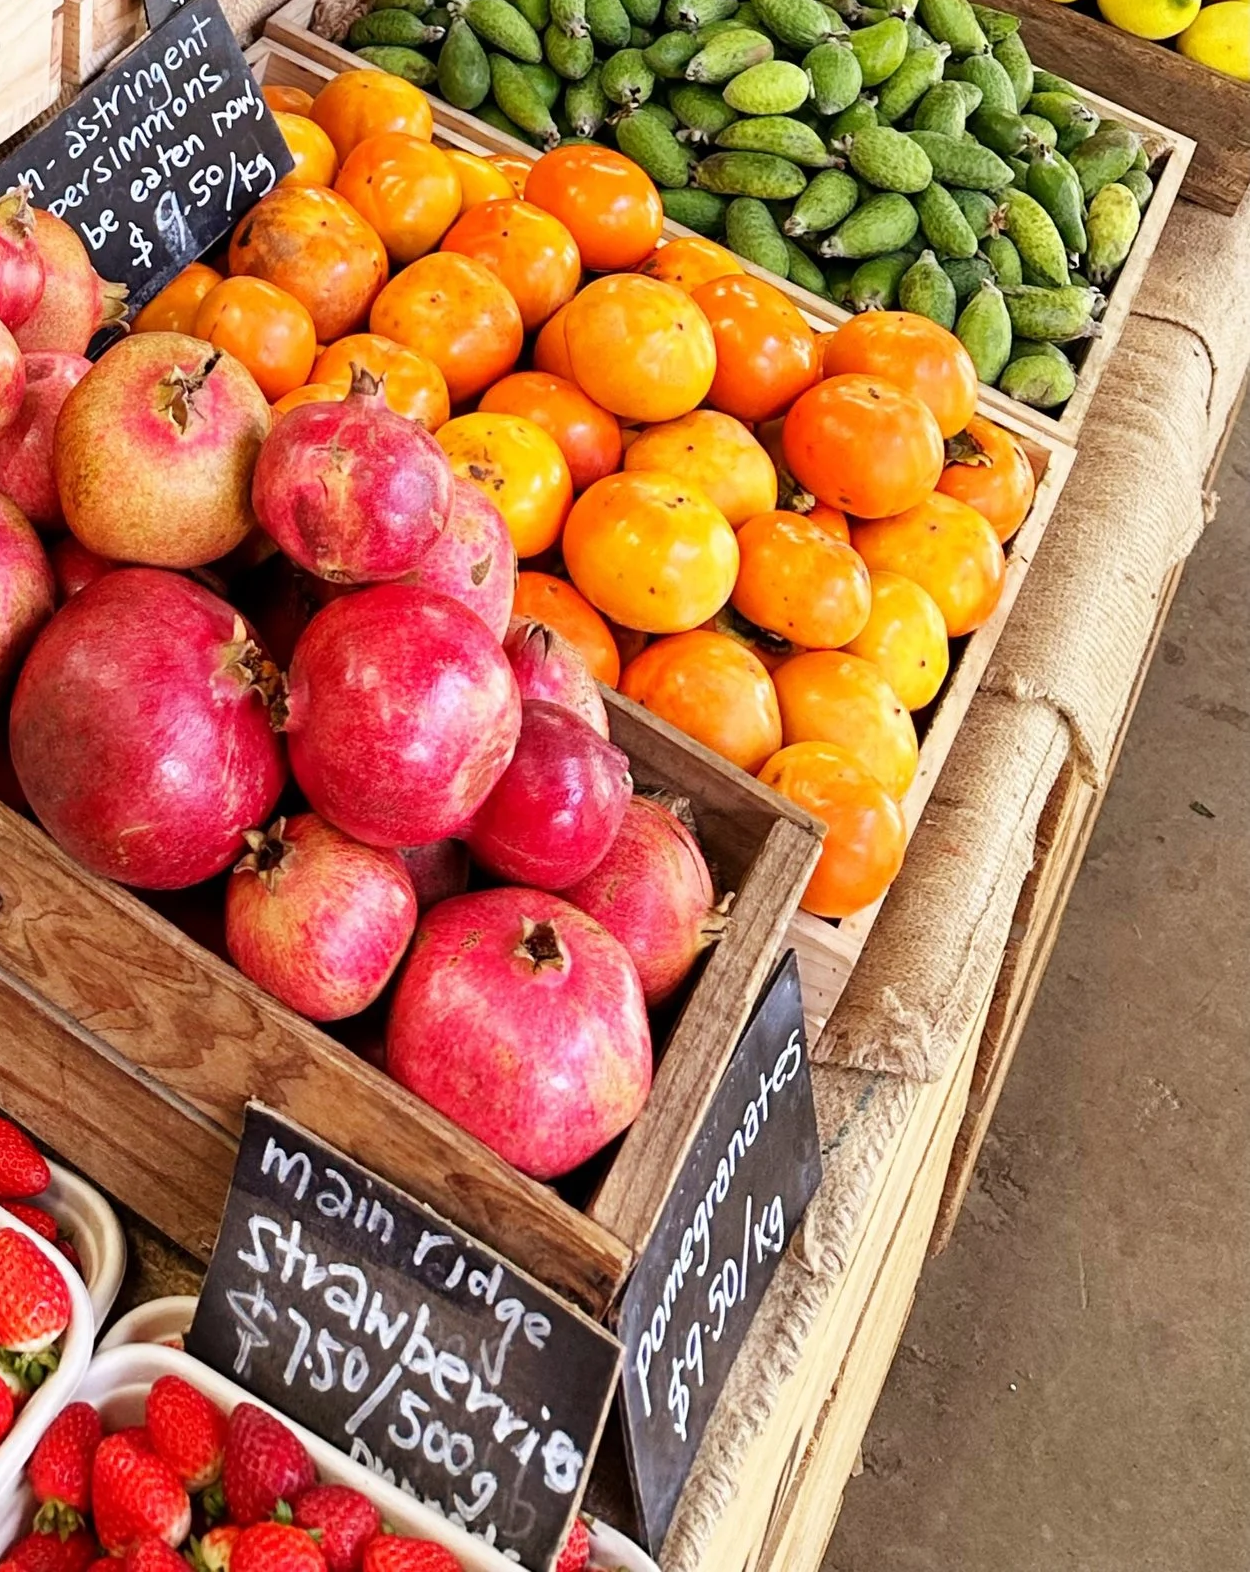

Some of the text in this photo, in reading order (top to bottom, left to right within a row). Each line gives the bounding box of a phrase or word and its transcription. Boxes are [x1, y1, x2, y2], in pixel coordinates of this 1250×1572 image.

[81, 209, 119, 250] be
[130, 134, 205, 203] eaten
[260, 1136, 552, 1387] main ridge
[636, 1028, 802, 1416] pomegranates
[666, 1194, 786, 1441] $9.50/kg
